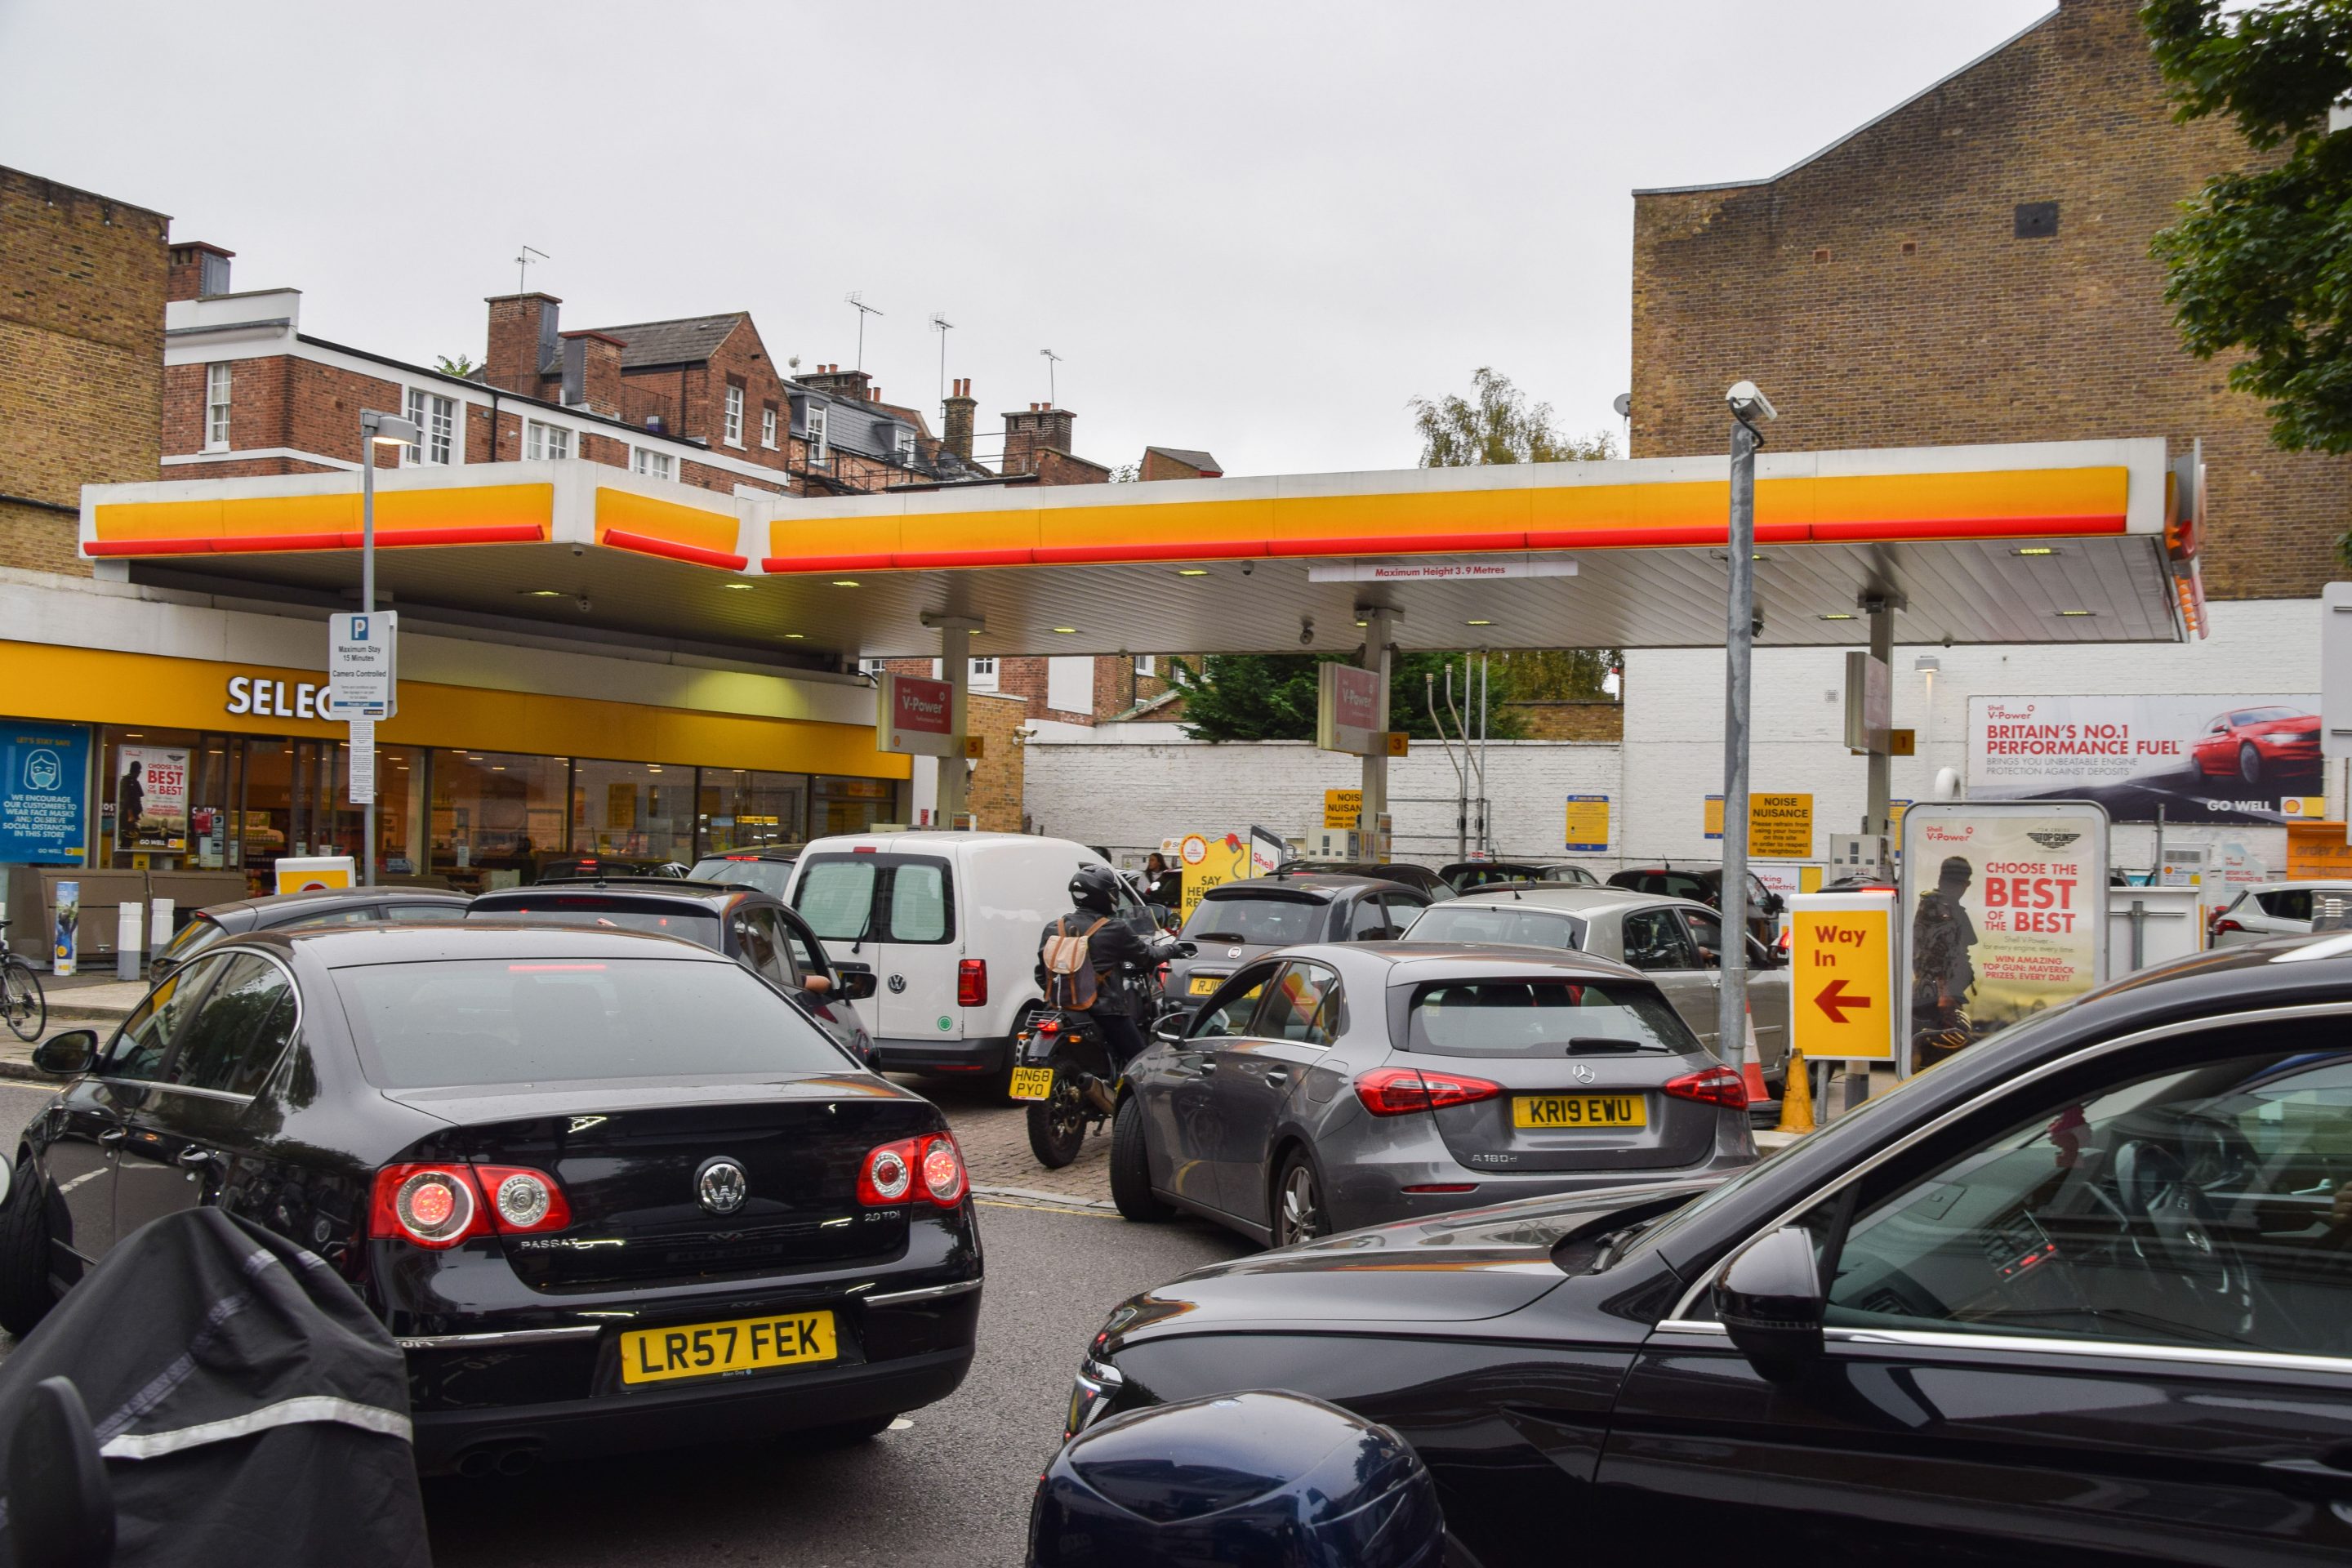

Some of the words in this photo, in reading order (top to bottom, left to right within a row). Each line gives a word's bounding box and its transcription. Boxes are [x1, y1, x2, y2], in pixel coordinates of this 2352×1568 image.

[1375, 568, 1420, 577] Maximum
[1423, 568, 1454, 577] Height
[1473, 566, 1506, 575] Metres
[368, 645, 381, 653] Stay
[1342, 687, 1373, 708] V-Power
[902, 695, 942, 715] V-Power
[1988, 711, 2032, 719] V-Power
[1987, 724, 2077, 739] BRITAIN'S
[2084, 724, 2129, 739] NO.1
[1393, 738, 1402, 751] 3
[1901, 736, 1907, 749] 1
[1987, 740, 2129, 755] PERFORMANCE
[1986, 758, 2020, 766] BRINGS
[2023, 758, 2042, 766] YOU
[2044, 758, 2099, 766] UNBEATABLE
[2101, 758, 2138, 766] ENGINE
[147, 770, 184, 786] BEST
[158, 786, 183, 795] BEST
[25, 795, 71, 803] ENCOURAGE
[1338, 793, 1362, 802] NOIS
[1764, 797, 1797, 807] NOISE
[23, 801, 66, 810] CUSTOMERS
[2207, 800, 2232, 812] GO
[2234, 800, 2272, 812] WELL
[1753, 808, 1808, 817] NUISANCE
[31, 823, 76, 831] DISTANCING
[1927, 833, 1971, 842] V-Power
[2296, 844, 2333, 857] order
[1254, 852, 1274, 871] Shell
[1986, 862, 2046, 875] CHOOSE
[2051, 863, 2078, 875] THE
[1201, 875, 1222, 886] SAY
[1985, 877, 2078, 910] BEST
[1987, 911, 2005, 920] OF
[1984, 920, 2007, 932] THE
[2014, 911, 2076, 933] BEST
[1815, 925, 1867, 948] Way
[1815, 950, 1837, 967] In
[2017, 956, 2063, 965] AMAZING
[2029, 964, 2075, 973] MAVERICK
[1986, 972, 2017, 980] PRIZES,
[1014, 1070, 1050, 1082] HN68
[1530, 1100, 1582, 1123] KR19
[1588, 1098, 1632, 1123] EWU
[882, 1209, 901, 1219] TDI
[521, 1238, 578, 1250] PASSAT
[639, 1326, 738, 1374] LR57
[750, 1318, 821, 1361] FEK
